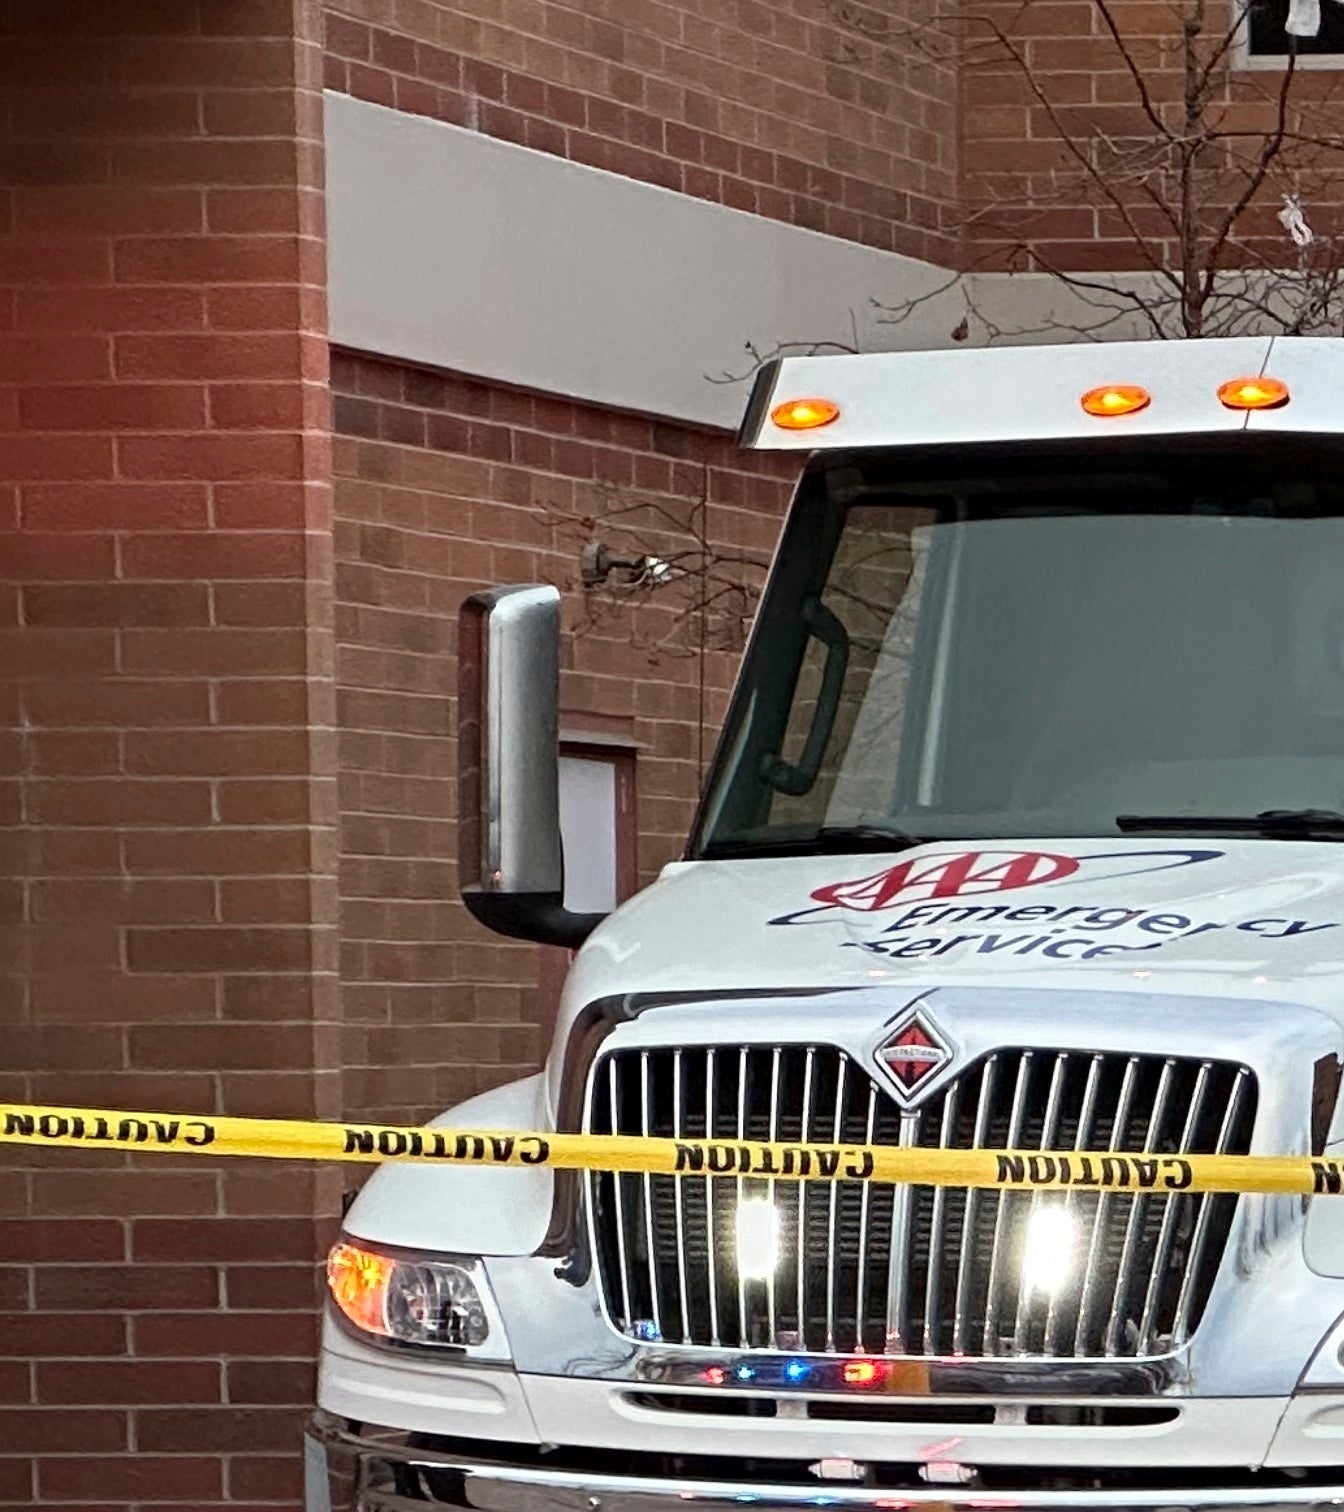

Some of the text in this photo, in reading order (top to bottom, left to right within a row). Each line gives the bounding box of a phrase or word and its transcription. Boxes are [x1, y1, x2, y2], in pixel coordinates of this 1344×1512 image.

[813, 850, 1079, 911] AAA
[882, 901, 1342, 938] Emergency
[4, 1113, 215, 1147] CAUTION
[344, 1128, 550, 1164] CAUTION
[676, 1143, 874, 1178] CAUTION
[997, 1154, 1192, 1189] CAUTION
